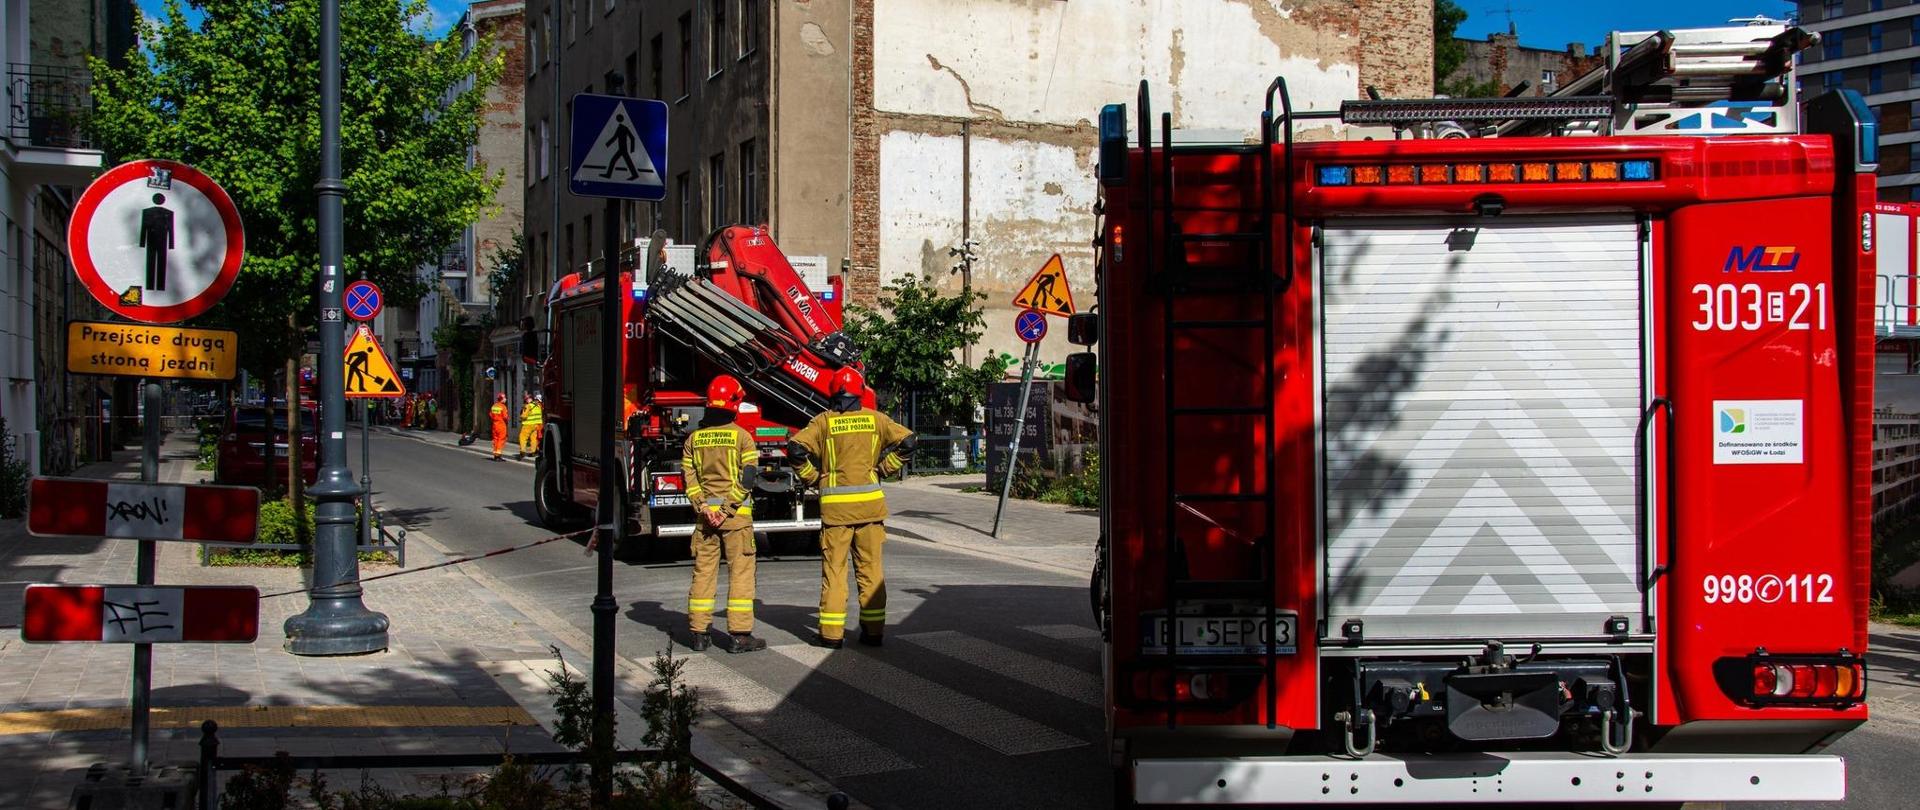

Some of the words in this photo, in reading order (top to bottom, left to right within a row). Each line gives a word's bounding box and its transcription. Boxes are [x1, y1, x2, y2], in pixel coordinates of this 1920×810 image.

[787, 285, 812, 317] HYVA
[82, 326, 161, 346] Przejście
[172, 333, 225, 353] drugą
[91, 352, 150, 371] stroną
[160, 355, 215, 372] jezdni
[1703, 574, 1753, 604] 998
[1785, 573, 1833, 603] 112
[1160, 619, 1194, 646] EL
